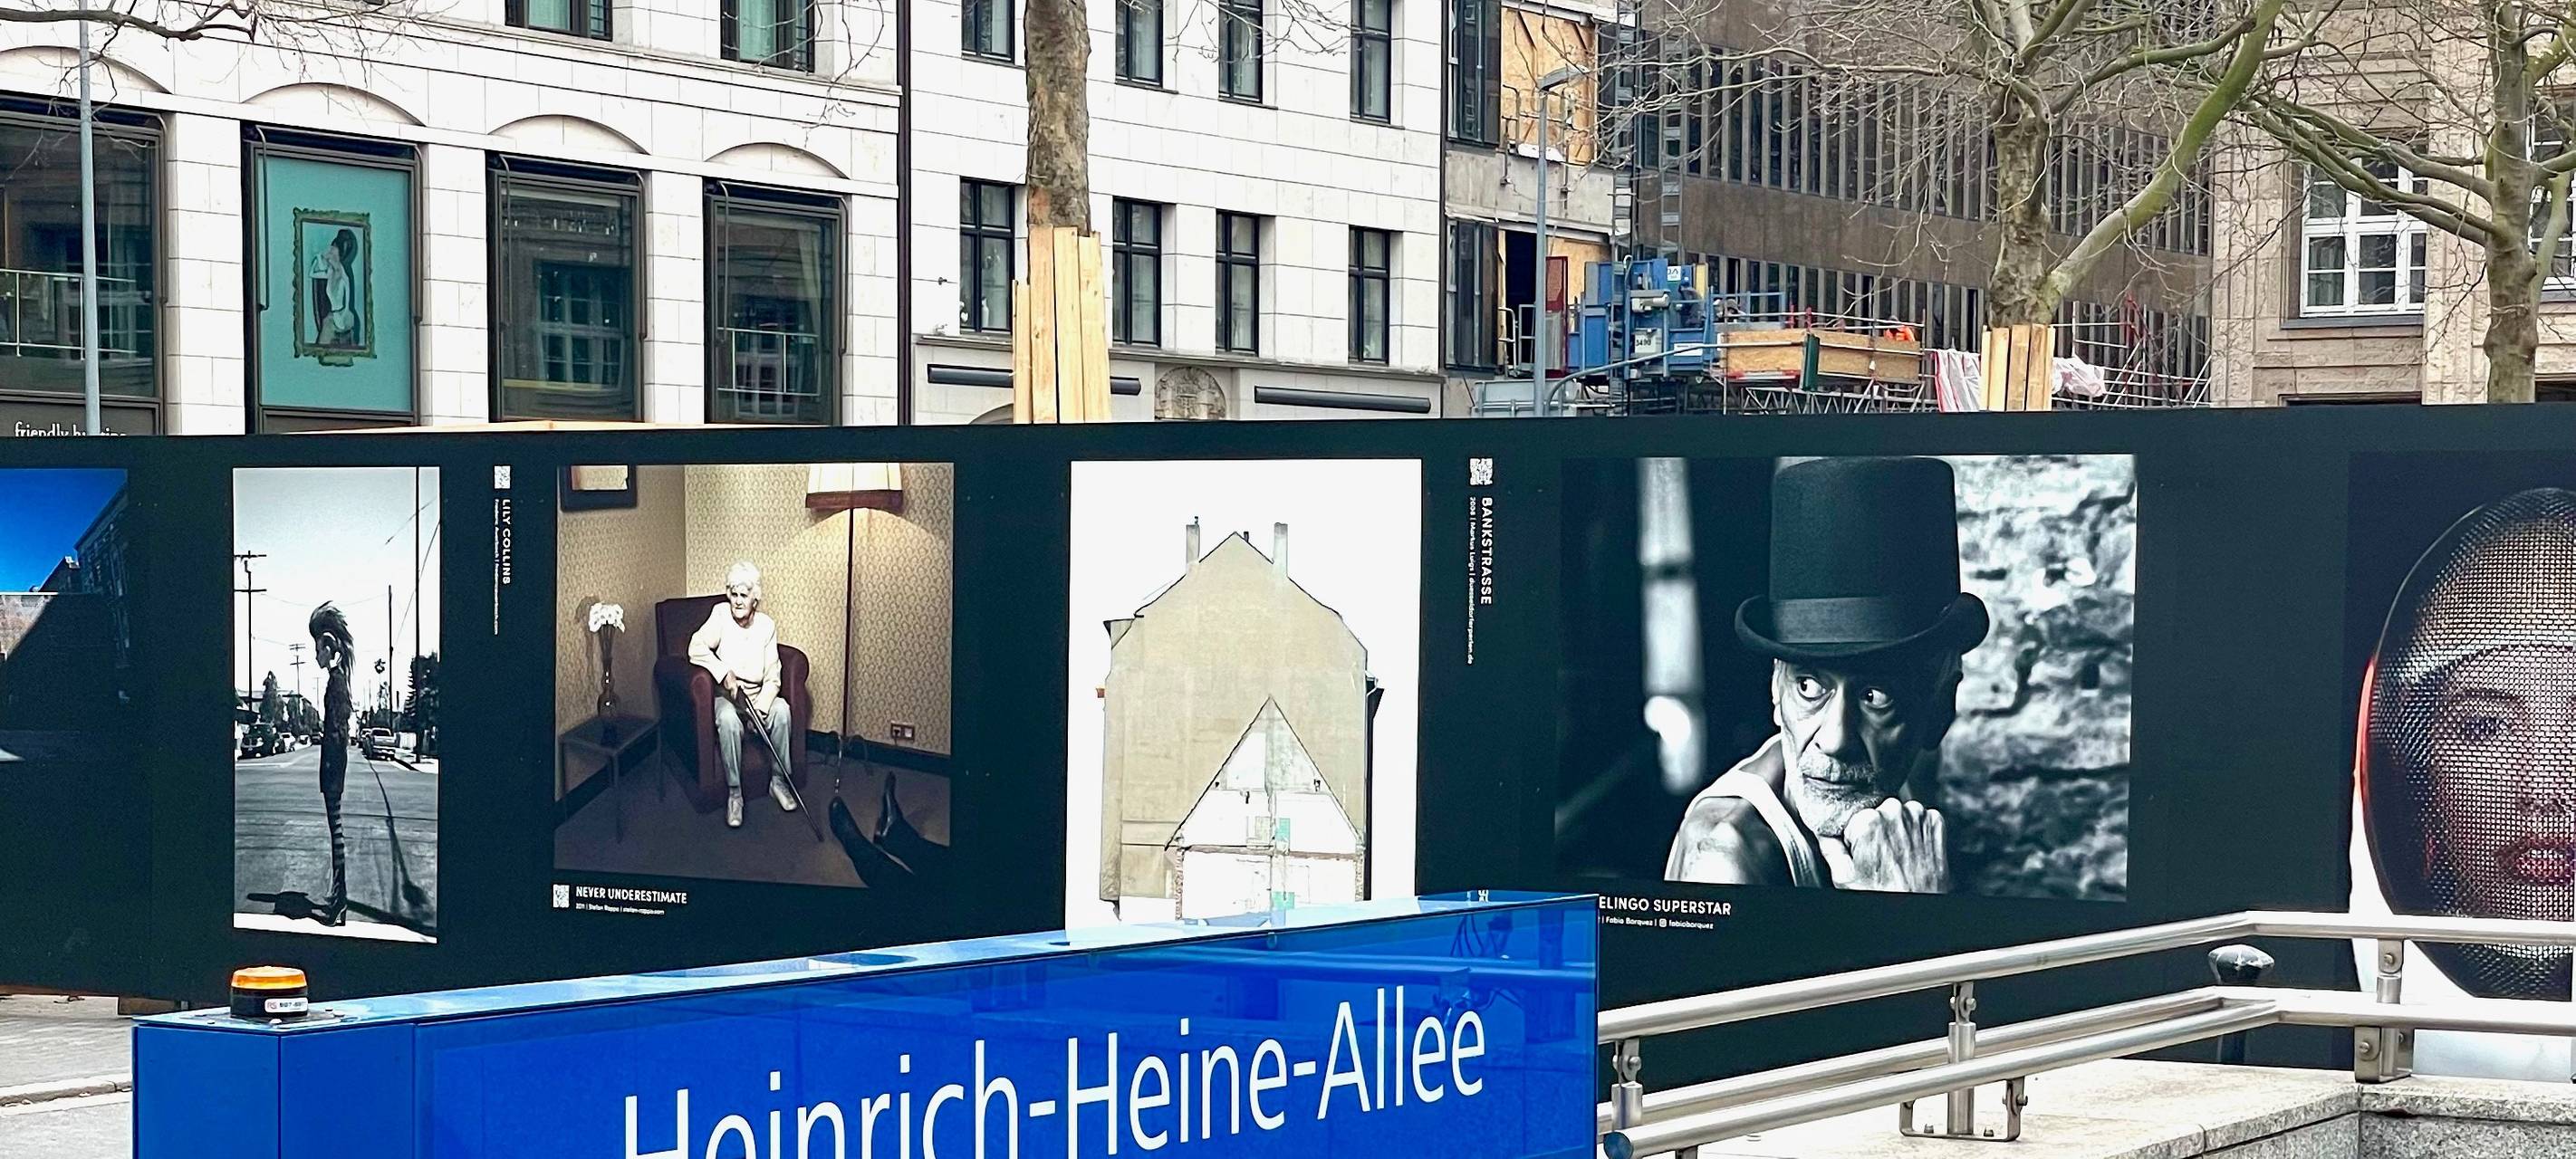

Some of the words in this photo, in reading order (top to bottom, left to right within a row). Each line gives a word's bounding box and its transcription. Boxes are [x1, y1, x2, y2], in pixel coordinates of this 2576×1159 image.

[502, 499, 511, 525] LILY
[502, 528, 511, 585] COLLINS
[1480, 497, 1493, 605] BANKSTRASSE
[575, 886, 606, 898] NEVER
[607, 888, 687, 904] UNDERESTIMATE
[1653, 899, 1732, 915] SUPERSTAR
[1605, 915, 1624, 924] Fabio
